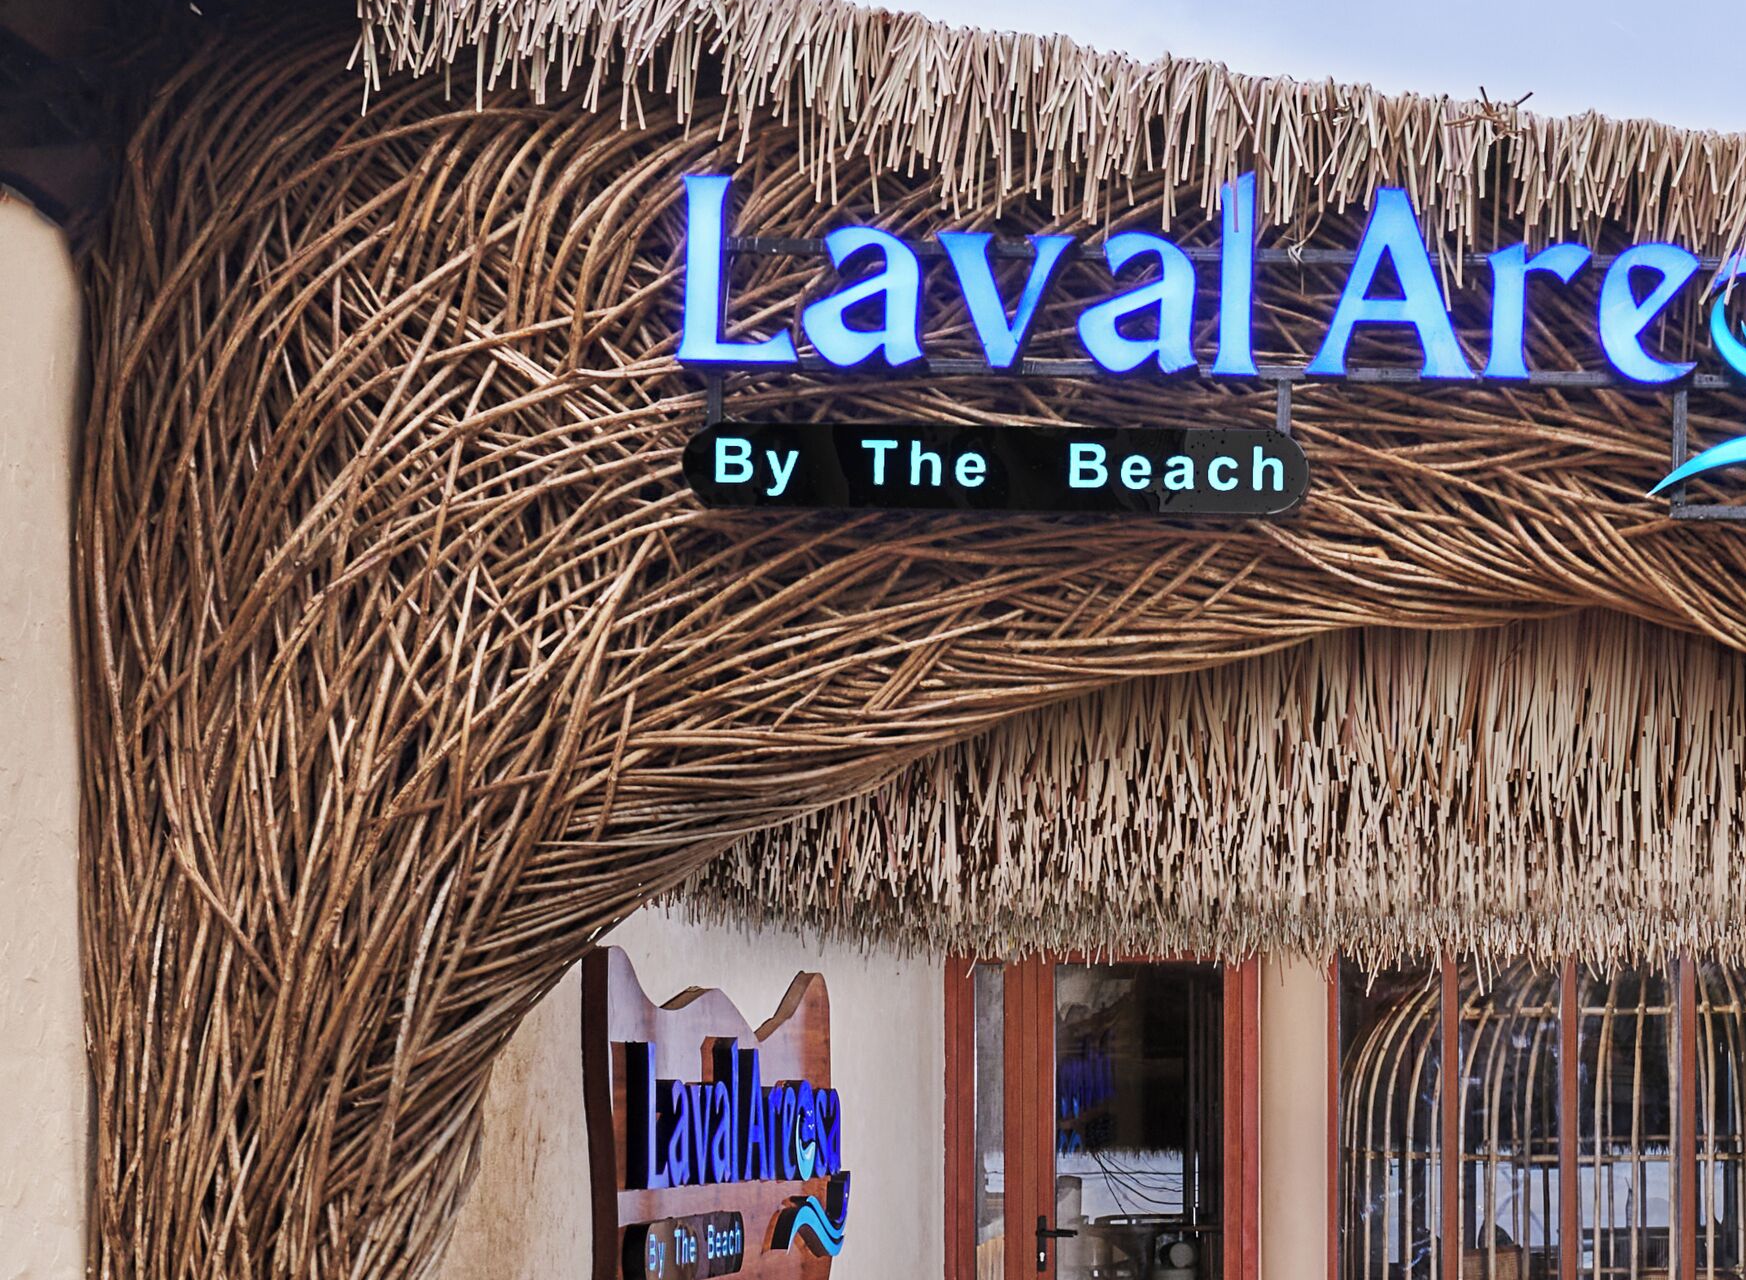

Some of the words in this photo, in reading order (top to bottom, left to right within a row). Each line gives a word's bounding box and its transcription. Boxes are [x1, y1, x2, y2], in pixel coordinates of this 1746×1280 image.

[675, 170, 1259, 377] Laval
[713, 438, 799, 497] By
[862, 438, 988, 489] The
[1070, 443, 1287, 493] Beach
[647, 1039, 739, 1189] Laval
[744, 1048, 841, 1182] Areosa
[648, 1233, 666, 1280] By
[674, 1229, 698, 1266] The
[707, 1223, 742, 1258] Beach
